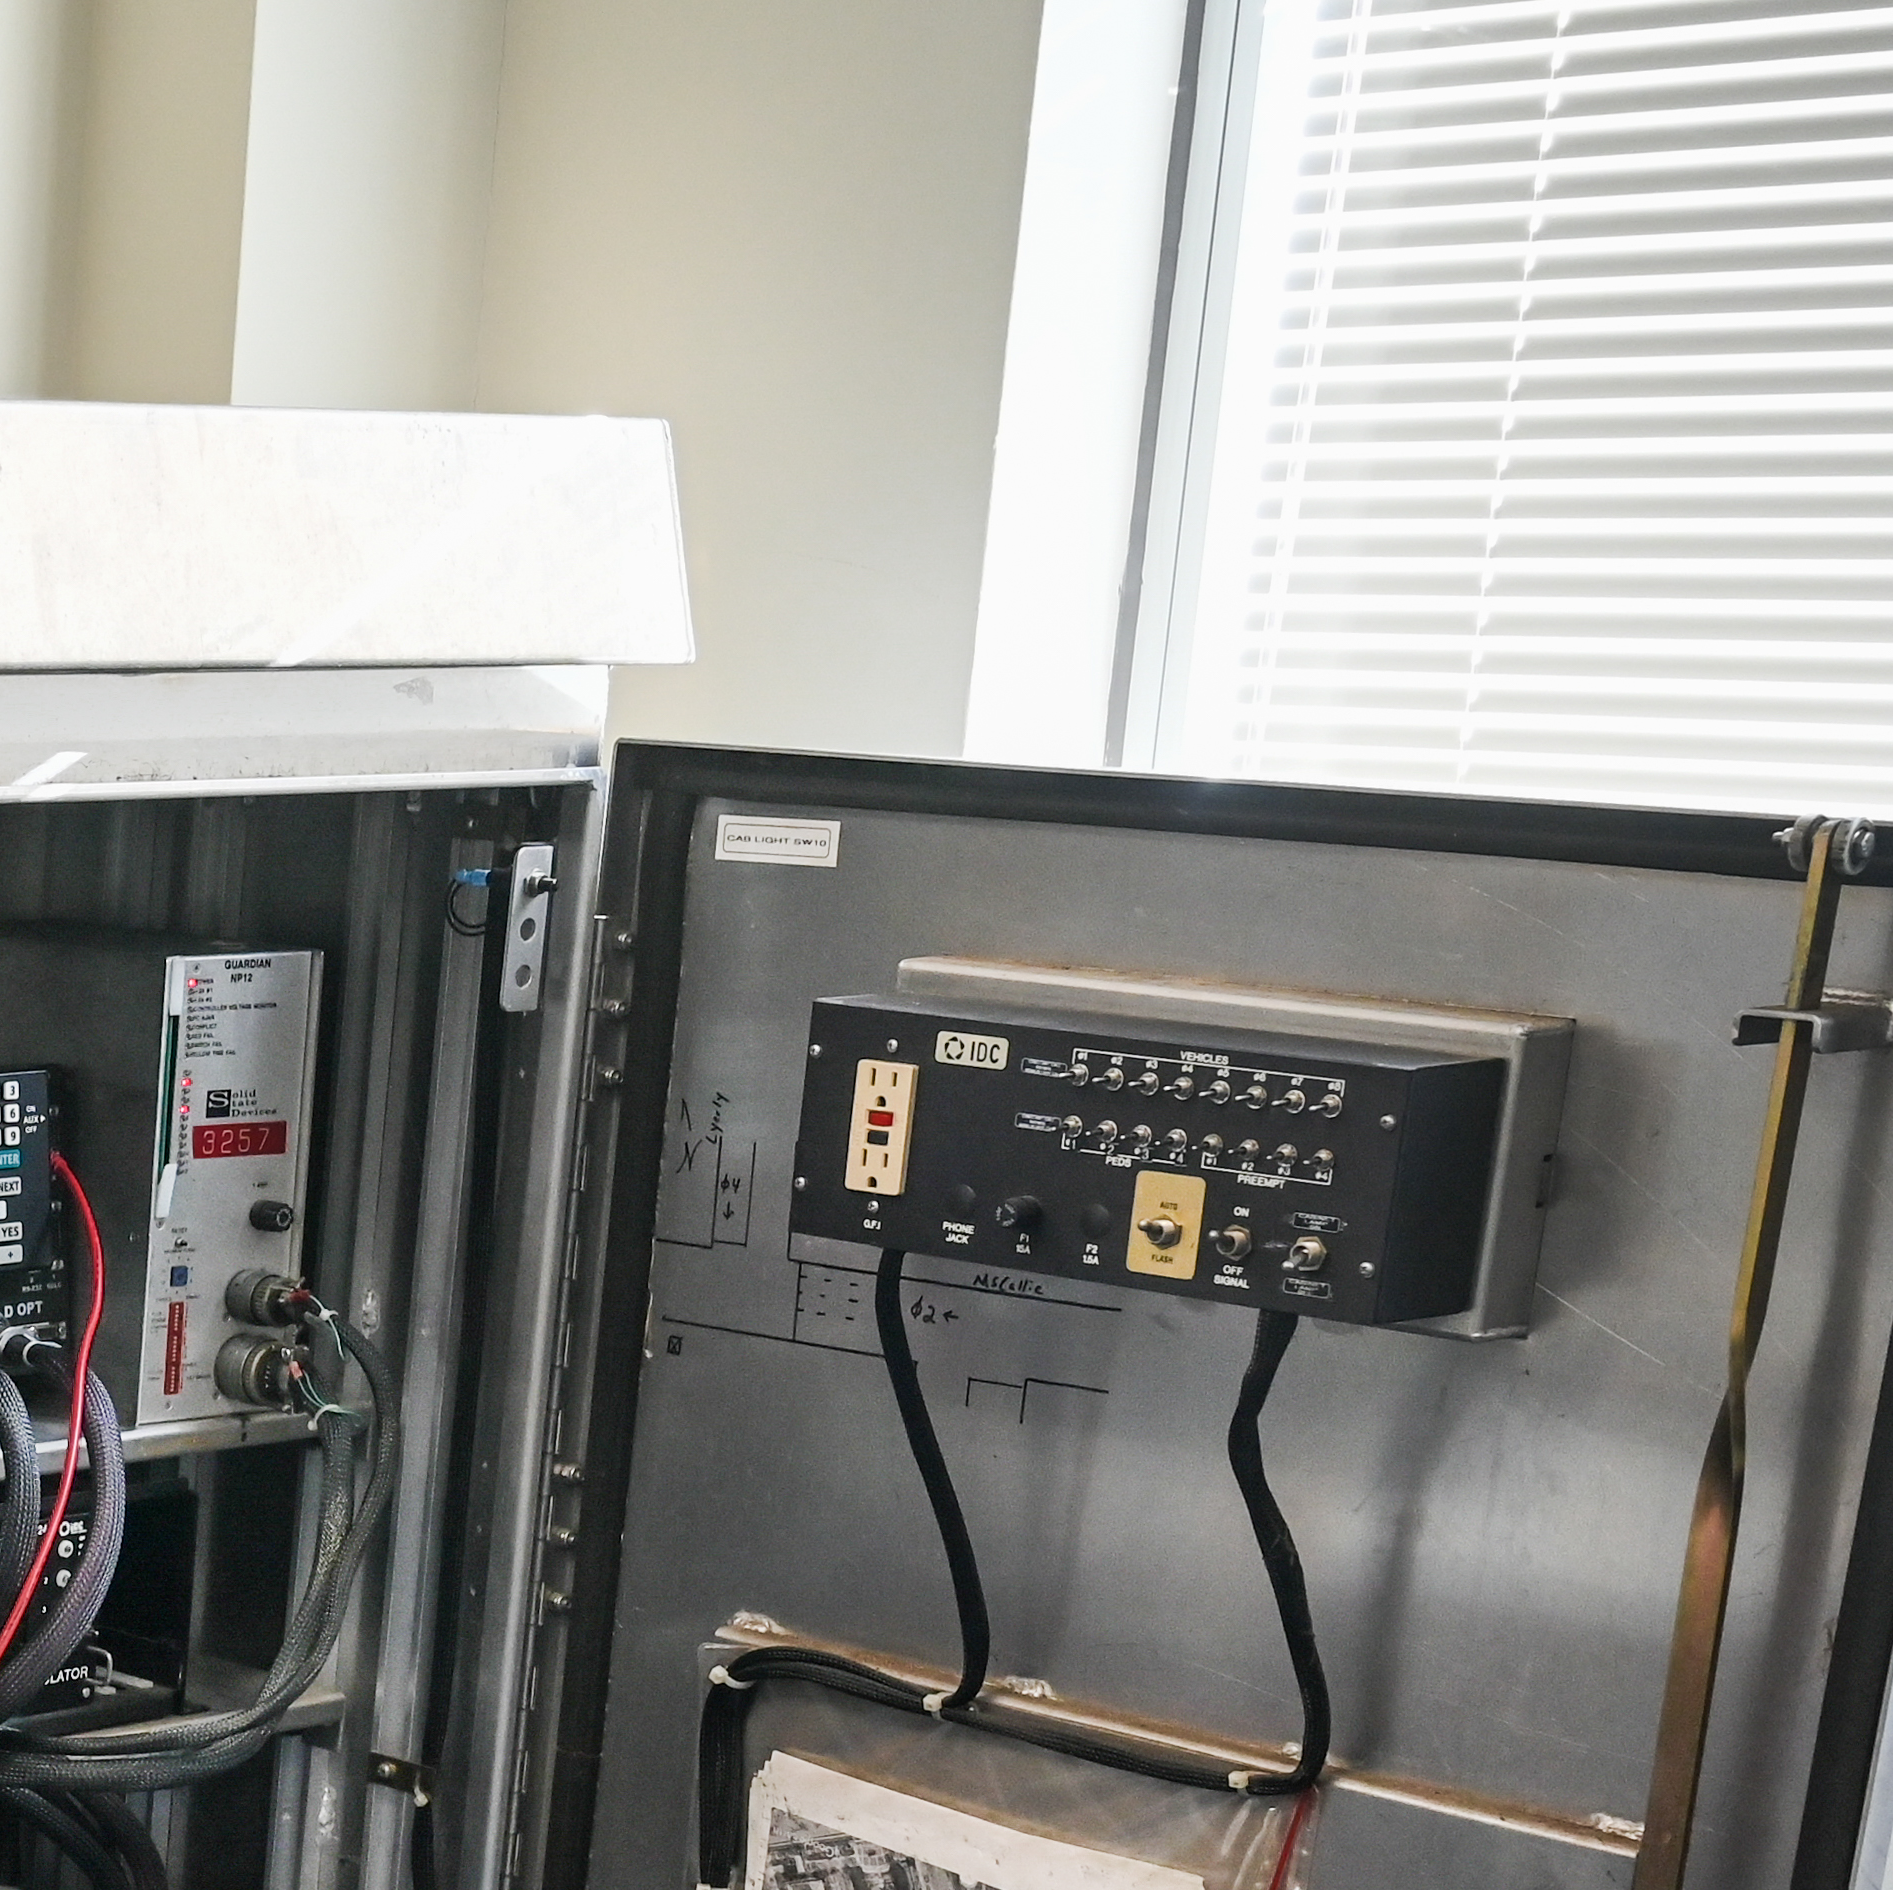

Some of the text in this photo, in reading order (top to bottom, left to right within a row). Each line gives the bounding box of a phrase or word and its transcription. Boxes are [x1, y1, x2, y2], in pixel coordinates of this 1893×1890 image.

[727, 834, 826, 847] CAB LIGHT SW10
[224, 959, 271, 970] GUARDIAN
[230, 973, 253, 983] NP12
[970, 1041, 1001, 1064] IDC
[1180, 1050, 1230, 1066] VEHICLES
[9, 1085, 16, 1095] 3
[10, 1108, 16, 1118] 6
[232, 1107, 277, 1118] Devices
[23, 1115, 39, 1124] AUX
[10, 1131, 16, 1141] 9
[202, 1127, 270, 1155] 3257
[1105, 1155, 1132, 1168] PEDS
[1237, 1173, 1286, 1189] PREEMPT
[1160, 1201, 1178, 1211] AUTO
[1233, 1206, 1250, 1218] ON
[1, 1226, 19, 1238] YES
[942, 1221, 976, 1235] PHONE
[945, 1233, 969, 1245] JACK
[1019, 1233, 1030, 1244] F1
[1086, 1243, 1099, 1255] F2
[1151, 1254, 1174, 1265] FLASH
[1222, 1264, 1244, 1276] OFF
[1213, 1275, 1250, 1289] SIGNAL
[4, 1300, 43, 1318] D OPT
